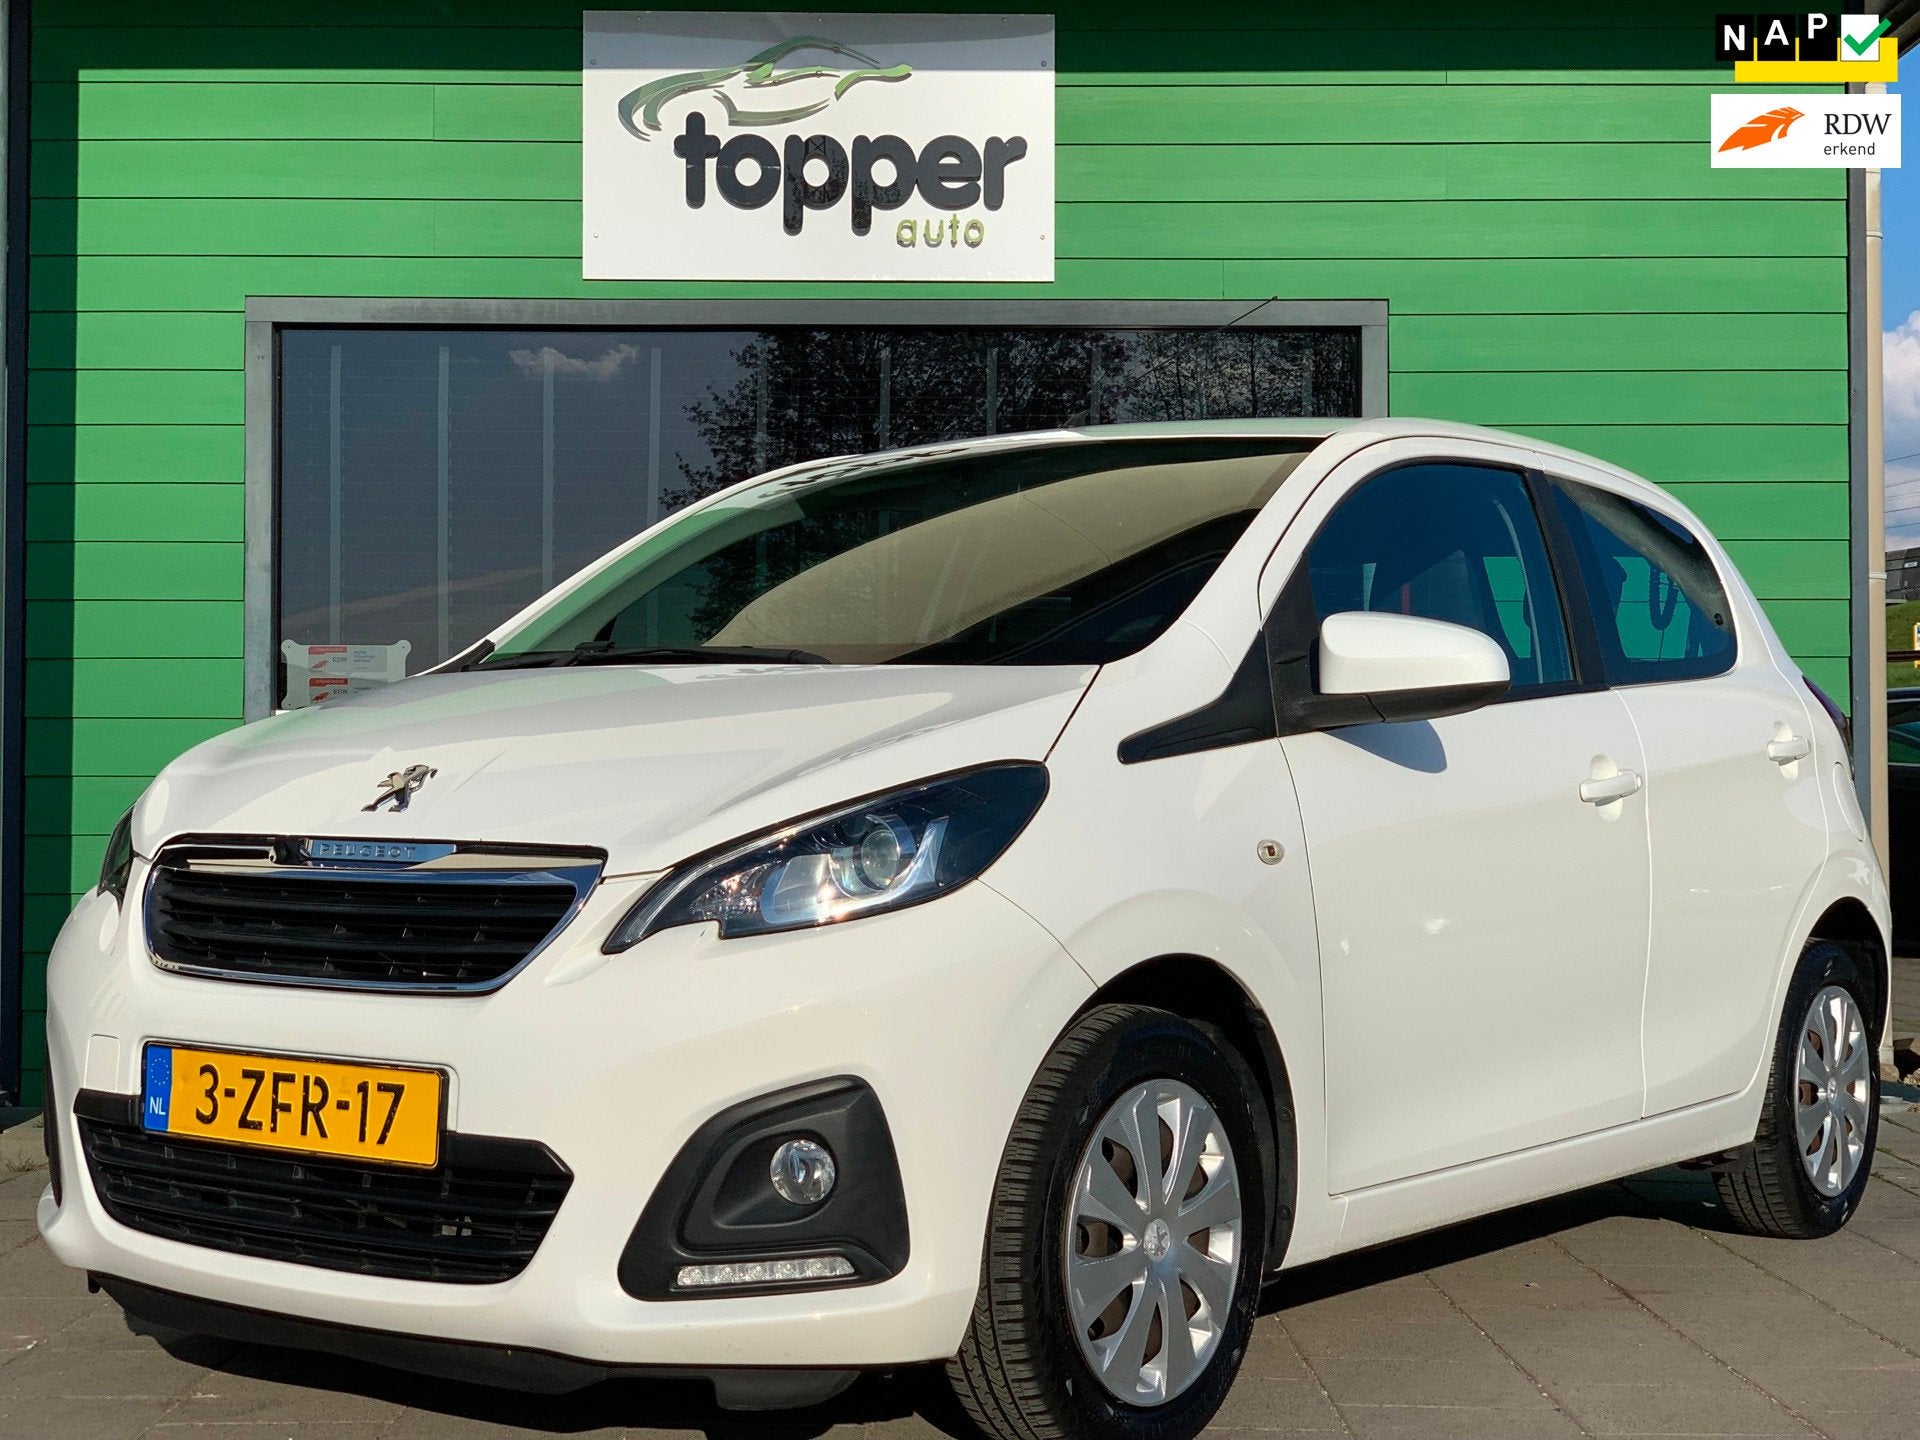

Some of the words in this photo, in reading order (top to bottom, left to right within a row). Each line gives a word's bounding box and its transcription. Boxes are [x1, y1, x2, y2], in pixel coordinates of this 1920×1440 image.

[673, 111, 1027, 236] topper
[896, 213, 985, 248] auto
[319, 843, 416, 859] PEUGEOT
[149, 1096, 166, 1116] NL
[195, 1063, 405, 1145] 3-ZFR-17
